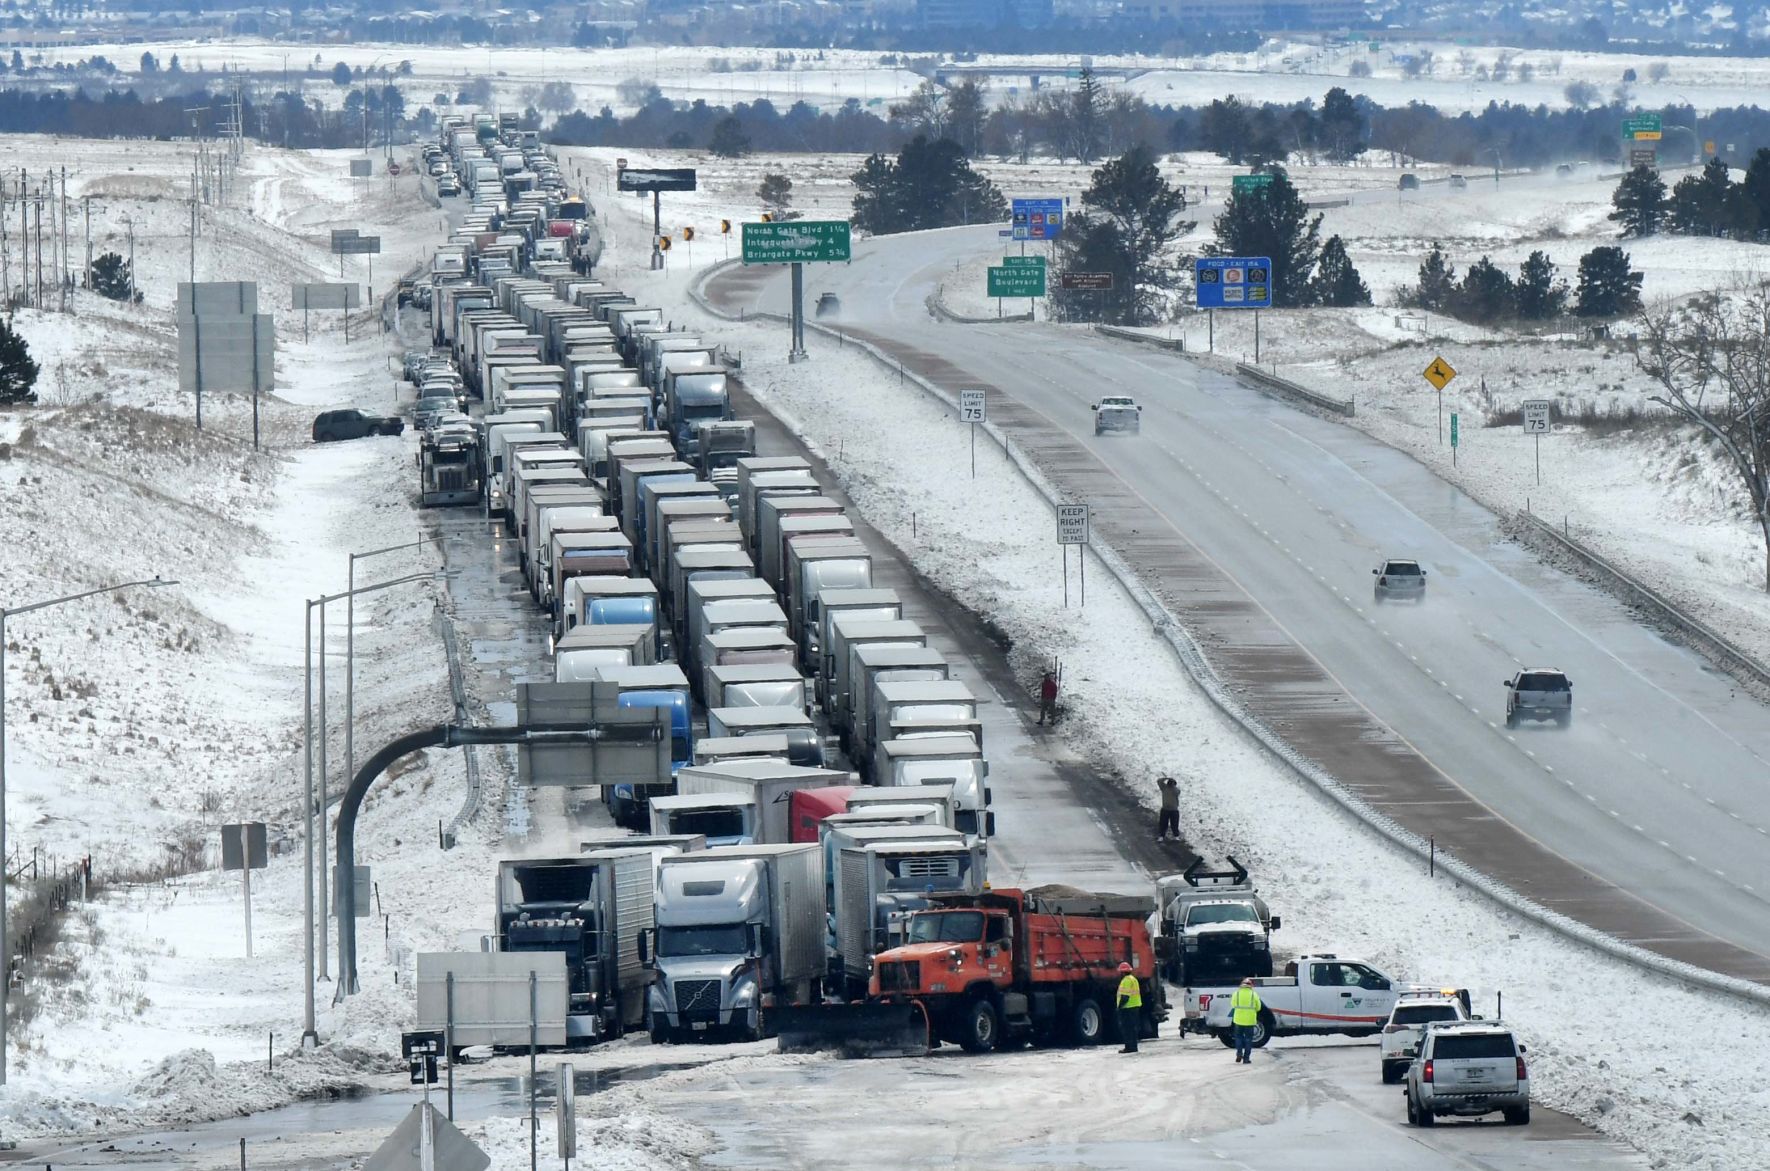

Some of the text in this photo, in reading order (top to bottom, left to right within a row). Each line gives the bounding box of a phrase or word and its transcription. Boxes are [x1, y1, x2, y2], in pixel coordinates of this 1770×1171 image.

[776, 226, 798, 234] Gate
[802, 226, 822, 234] Blvd
[827, 237, 834, 245] 4
[747, 250, 791, 259] Briargate
[794, 249, 819, 258] Pkwy
[993, 269, 1018, 277] North
[995, 278, 1038, 286] Boulevard
[965, 408, 982, 419] 75
[1529, 419, 1545, 430] 75
[1061, 508, 1084, 516] KEEP
[1060, 517, 1085, 526] RIGHT
